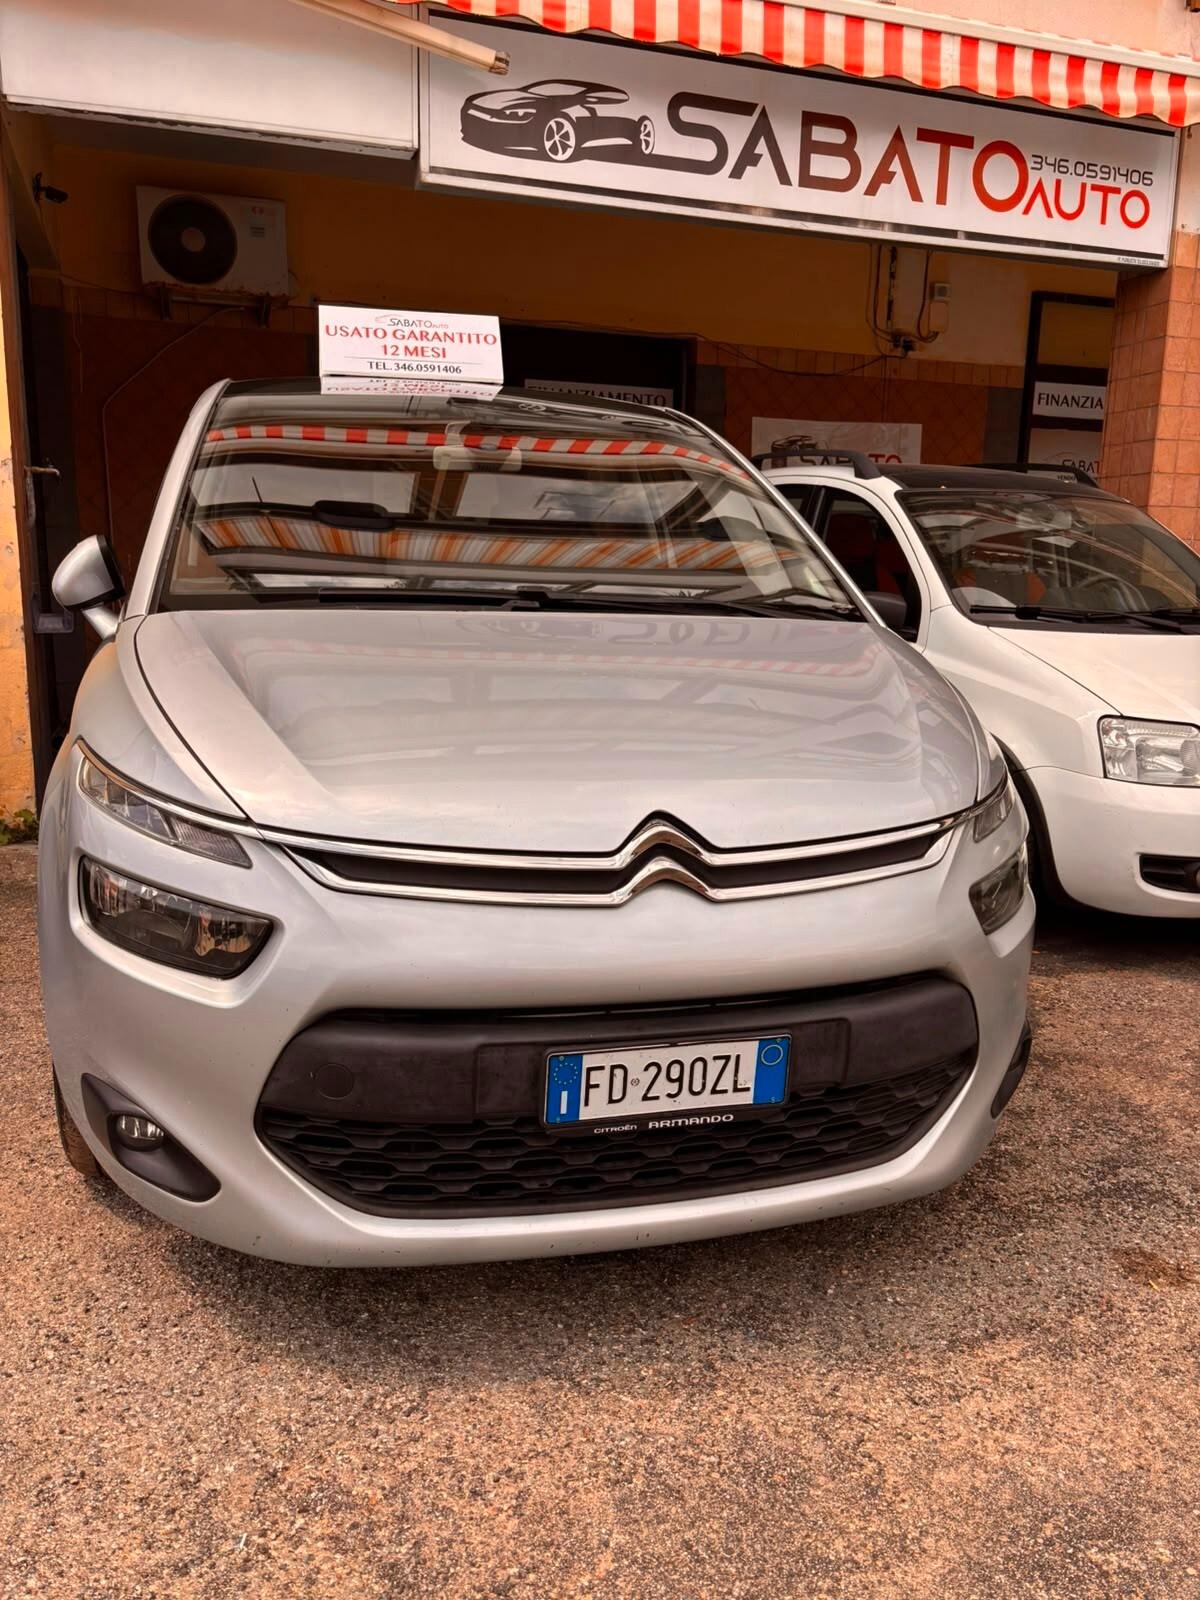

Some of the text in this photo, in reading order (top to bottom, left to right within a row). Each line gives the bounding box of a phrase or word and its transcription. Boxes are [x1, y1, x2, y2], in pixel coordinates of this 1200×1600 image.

[658, 91, 1150, 229] SABATO AUTO
[1030, 154, 1154, 187] 346.0591406
[325, 325, 497, 345] USATO GARANTITO
[387, 318, 433, 328] SABATO
[382, 344, 447, 359] 12 MESI
[584, 1054, 751, 1107] FD 290ZL
